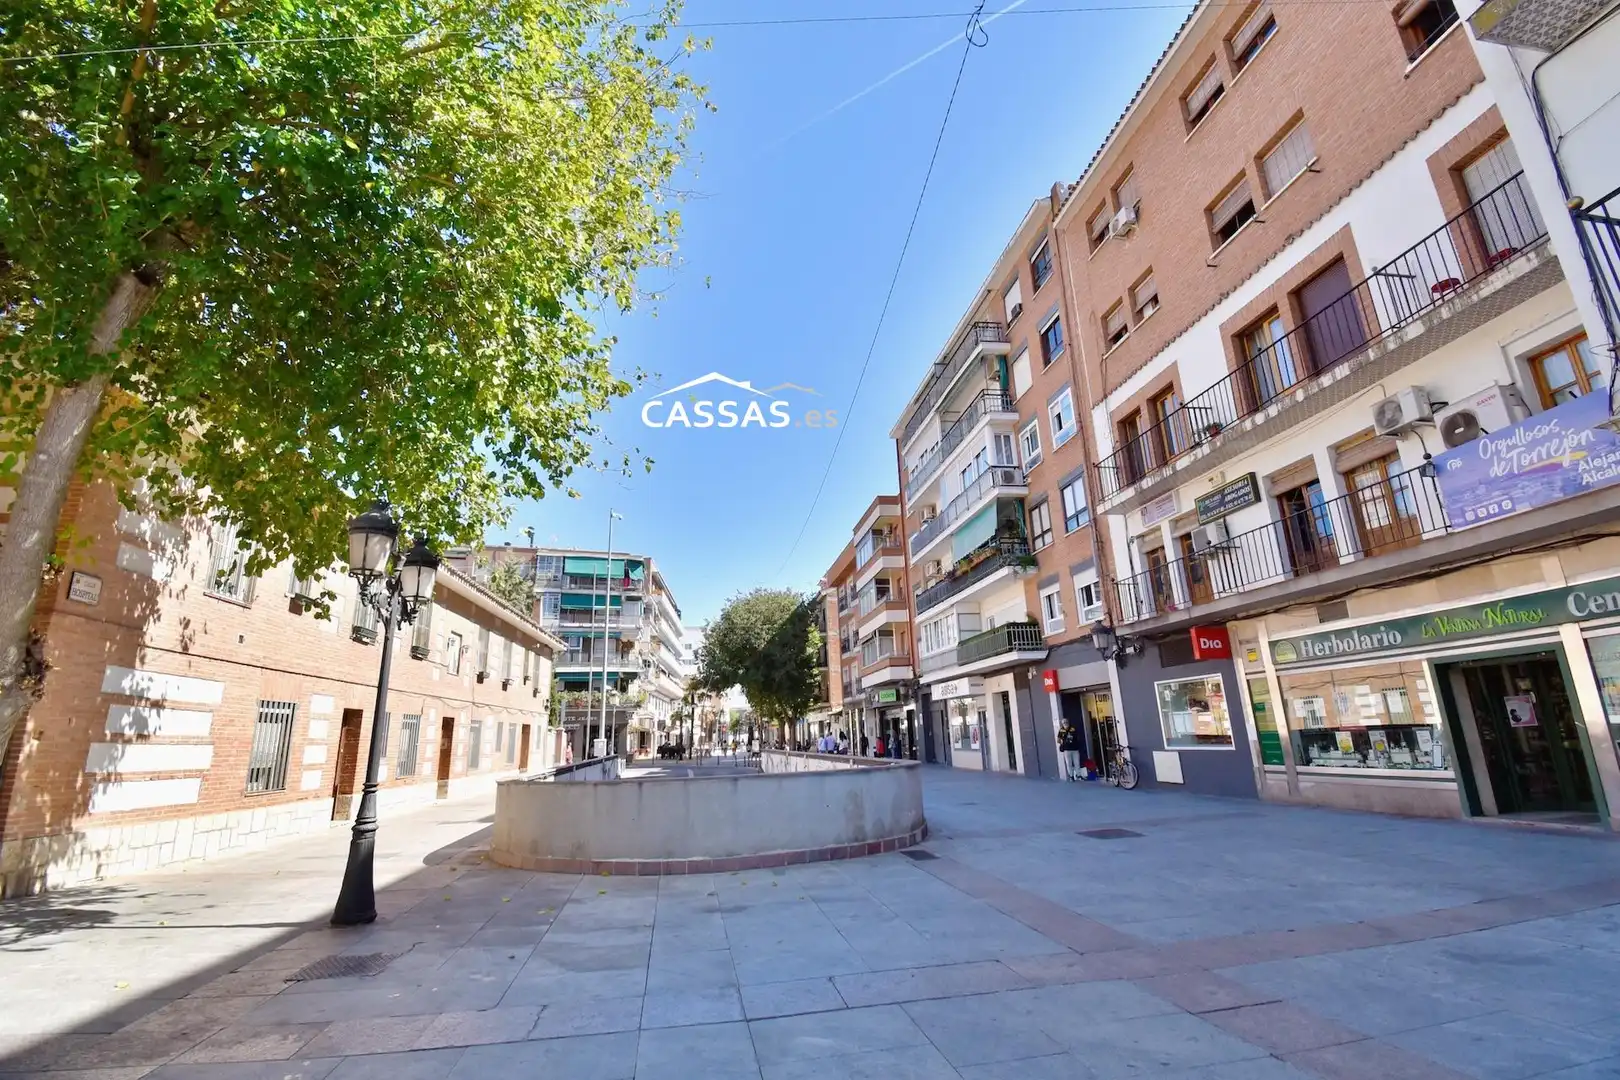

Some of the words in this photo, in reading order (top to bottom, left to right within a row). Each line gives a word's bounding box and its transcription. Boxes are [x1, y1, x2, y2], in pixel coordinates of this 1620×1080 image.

[1479, 419, 1560, 459] Orgullosos
[1490, 457, 1511, 477] de
[1507, 428, 1596, 474] Torrejón
[72, 588, 97, 601] HOSPITAL
[1301, 626, 1402, 657] Herbolario
